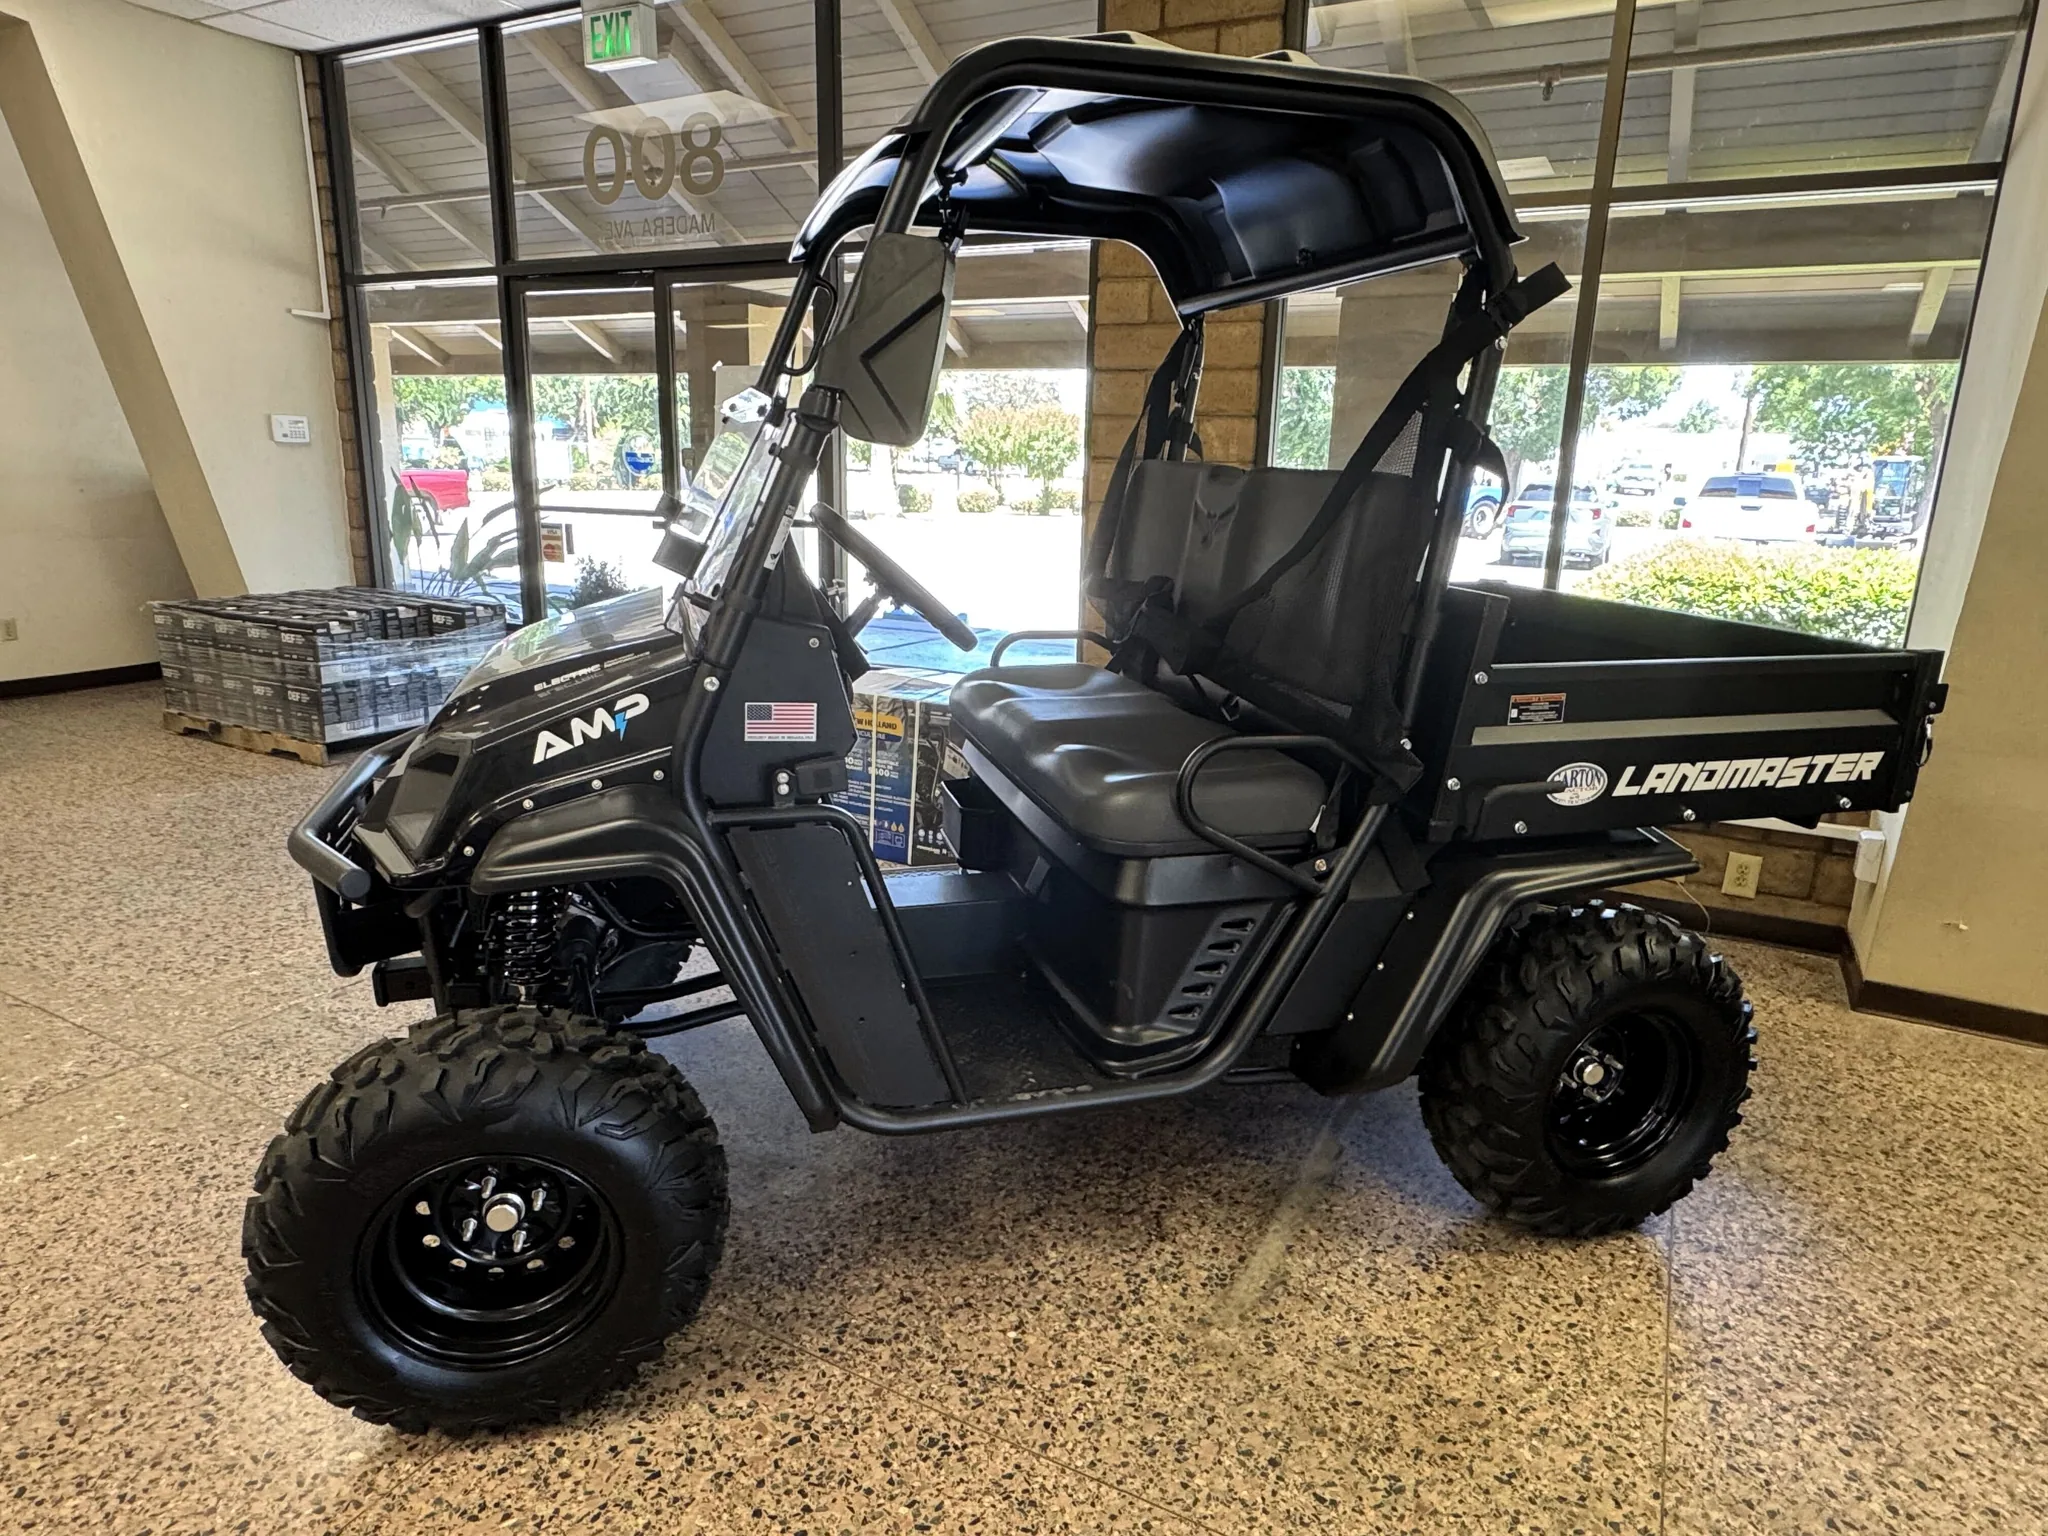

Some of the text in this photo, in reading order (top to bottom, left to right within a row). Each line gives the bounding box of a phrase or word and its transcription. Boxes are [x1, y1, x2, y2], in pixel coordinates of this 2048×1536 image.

[590, 10, 632, 60] EXIT
[281, 632, 295, 644] DEF
[533, 693, 650, 764] AMP
[1612, 751, 1886, 797] LANDMASTER
